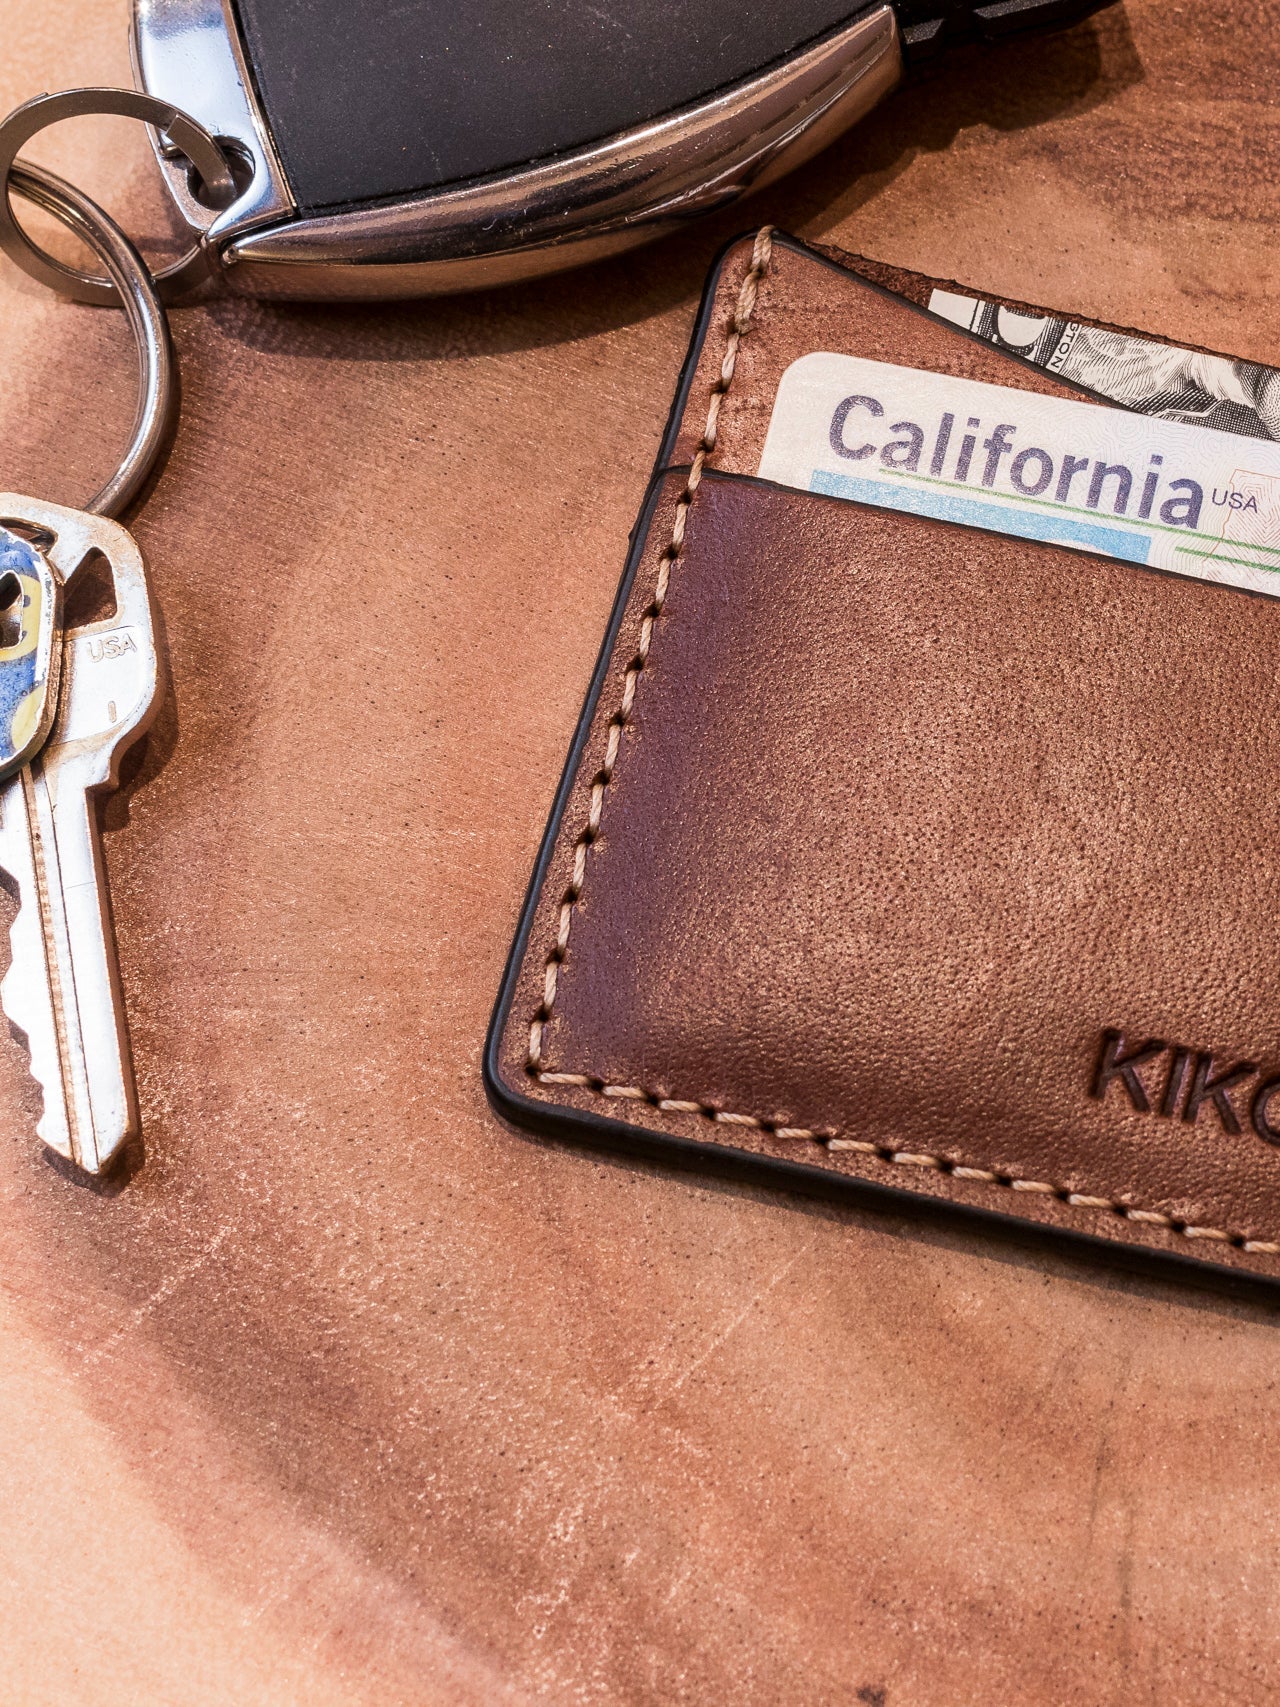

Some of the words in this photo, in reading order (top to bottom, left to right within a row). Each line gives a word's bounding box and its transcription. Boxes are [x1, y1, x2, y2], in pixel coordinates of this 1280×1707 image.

[829, 394, 1204, 530] California
[1211, 488, 1258, 513] USA
[87, 633, 137, 663] USA
